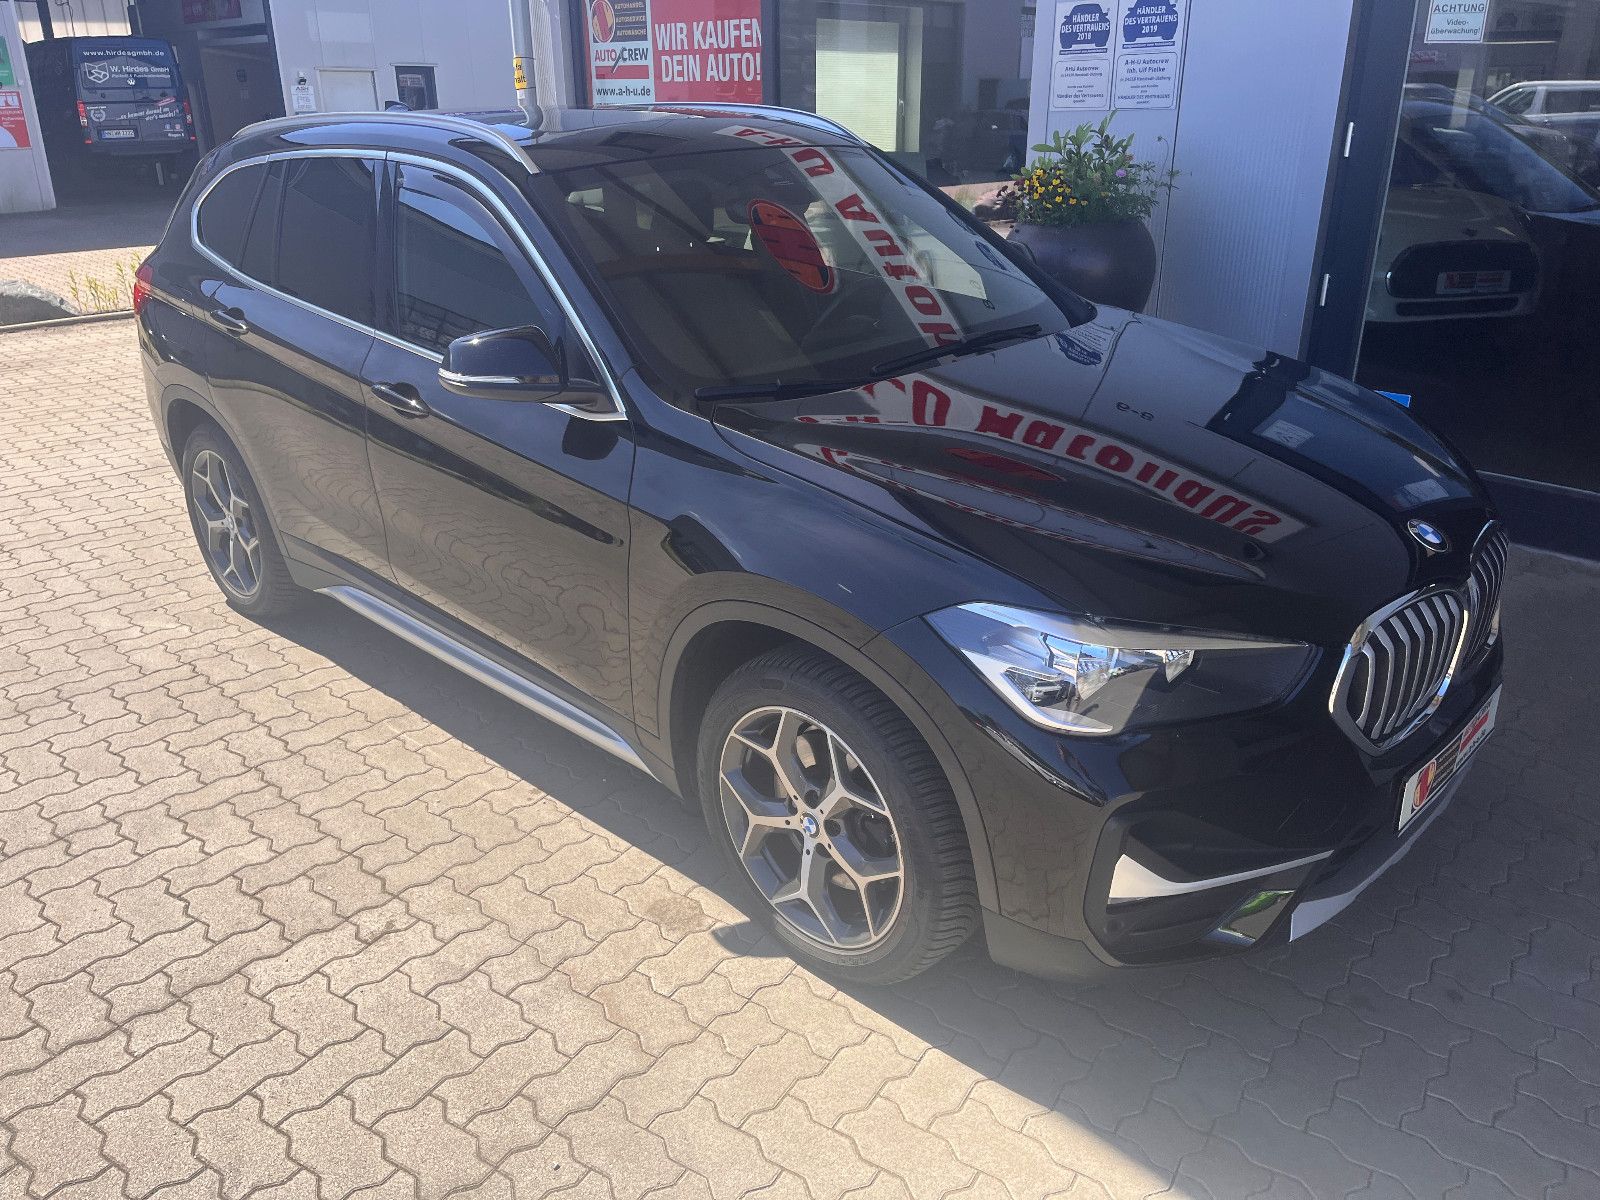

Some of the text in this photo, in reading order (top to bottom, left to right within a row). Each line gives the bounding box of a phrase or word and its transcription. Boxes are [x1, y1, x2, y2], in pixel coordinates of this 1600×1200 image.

[1137, 6, 1166, 14] HÄNDLER
[1433, 4, 1485, 12] ACHTUNG
[1073, 13, 1099, 22] HÄNDLER
[1137, 14, 1177, 24] VERTRAUENS
[1061, 22, 1109, 33] DES VERTRAUENS
[1142, 25, 1157, 33] 2019
[655, 18, 762, 50] WIR KAUFEN
[595, 47, 649, 62] AUTO CREW
[661, 53, 761, 82] DEIN AUTO!
[596, 85, 651, 96] www.a-h-u.de
